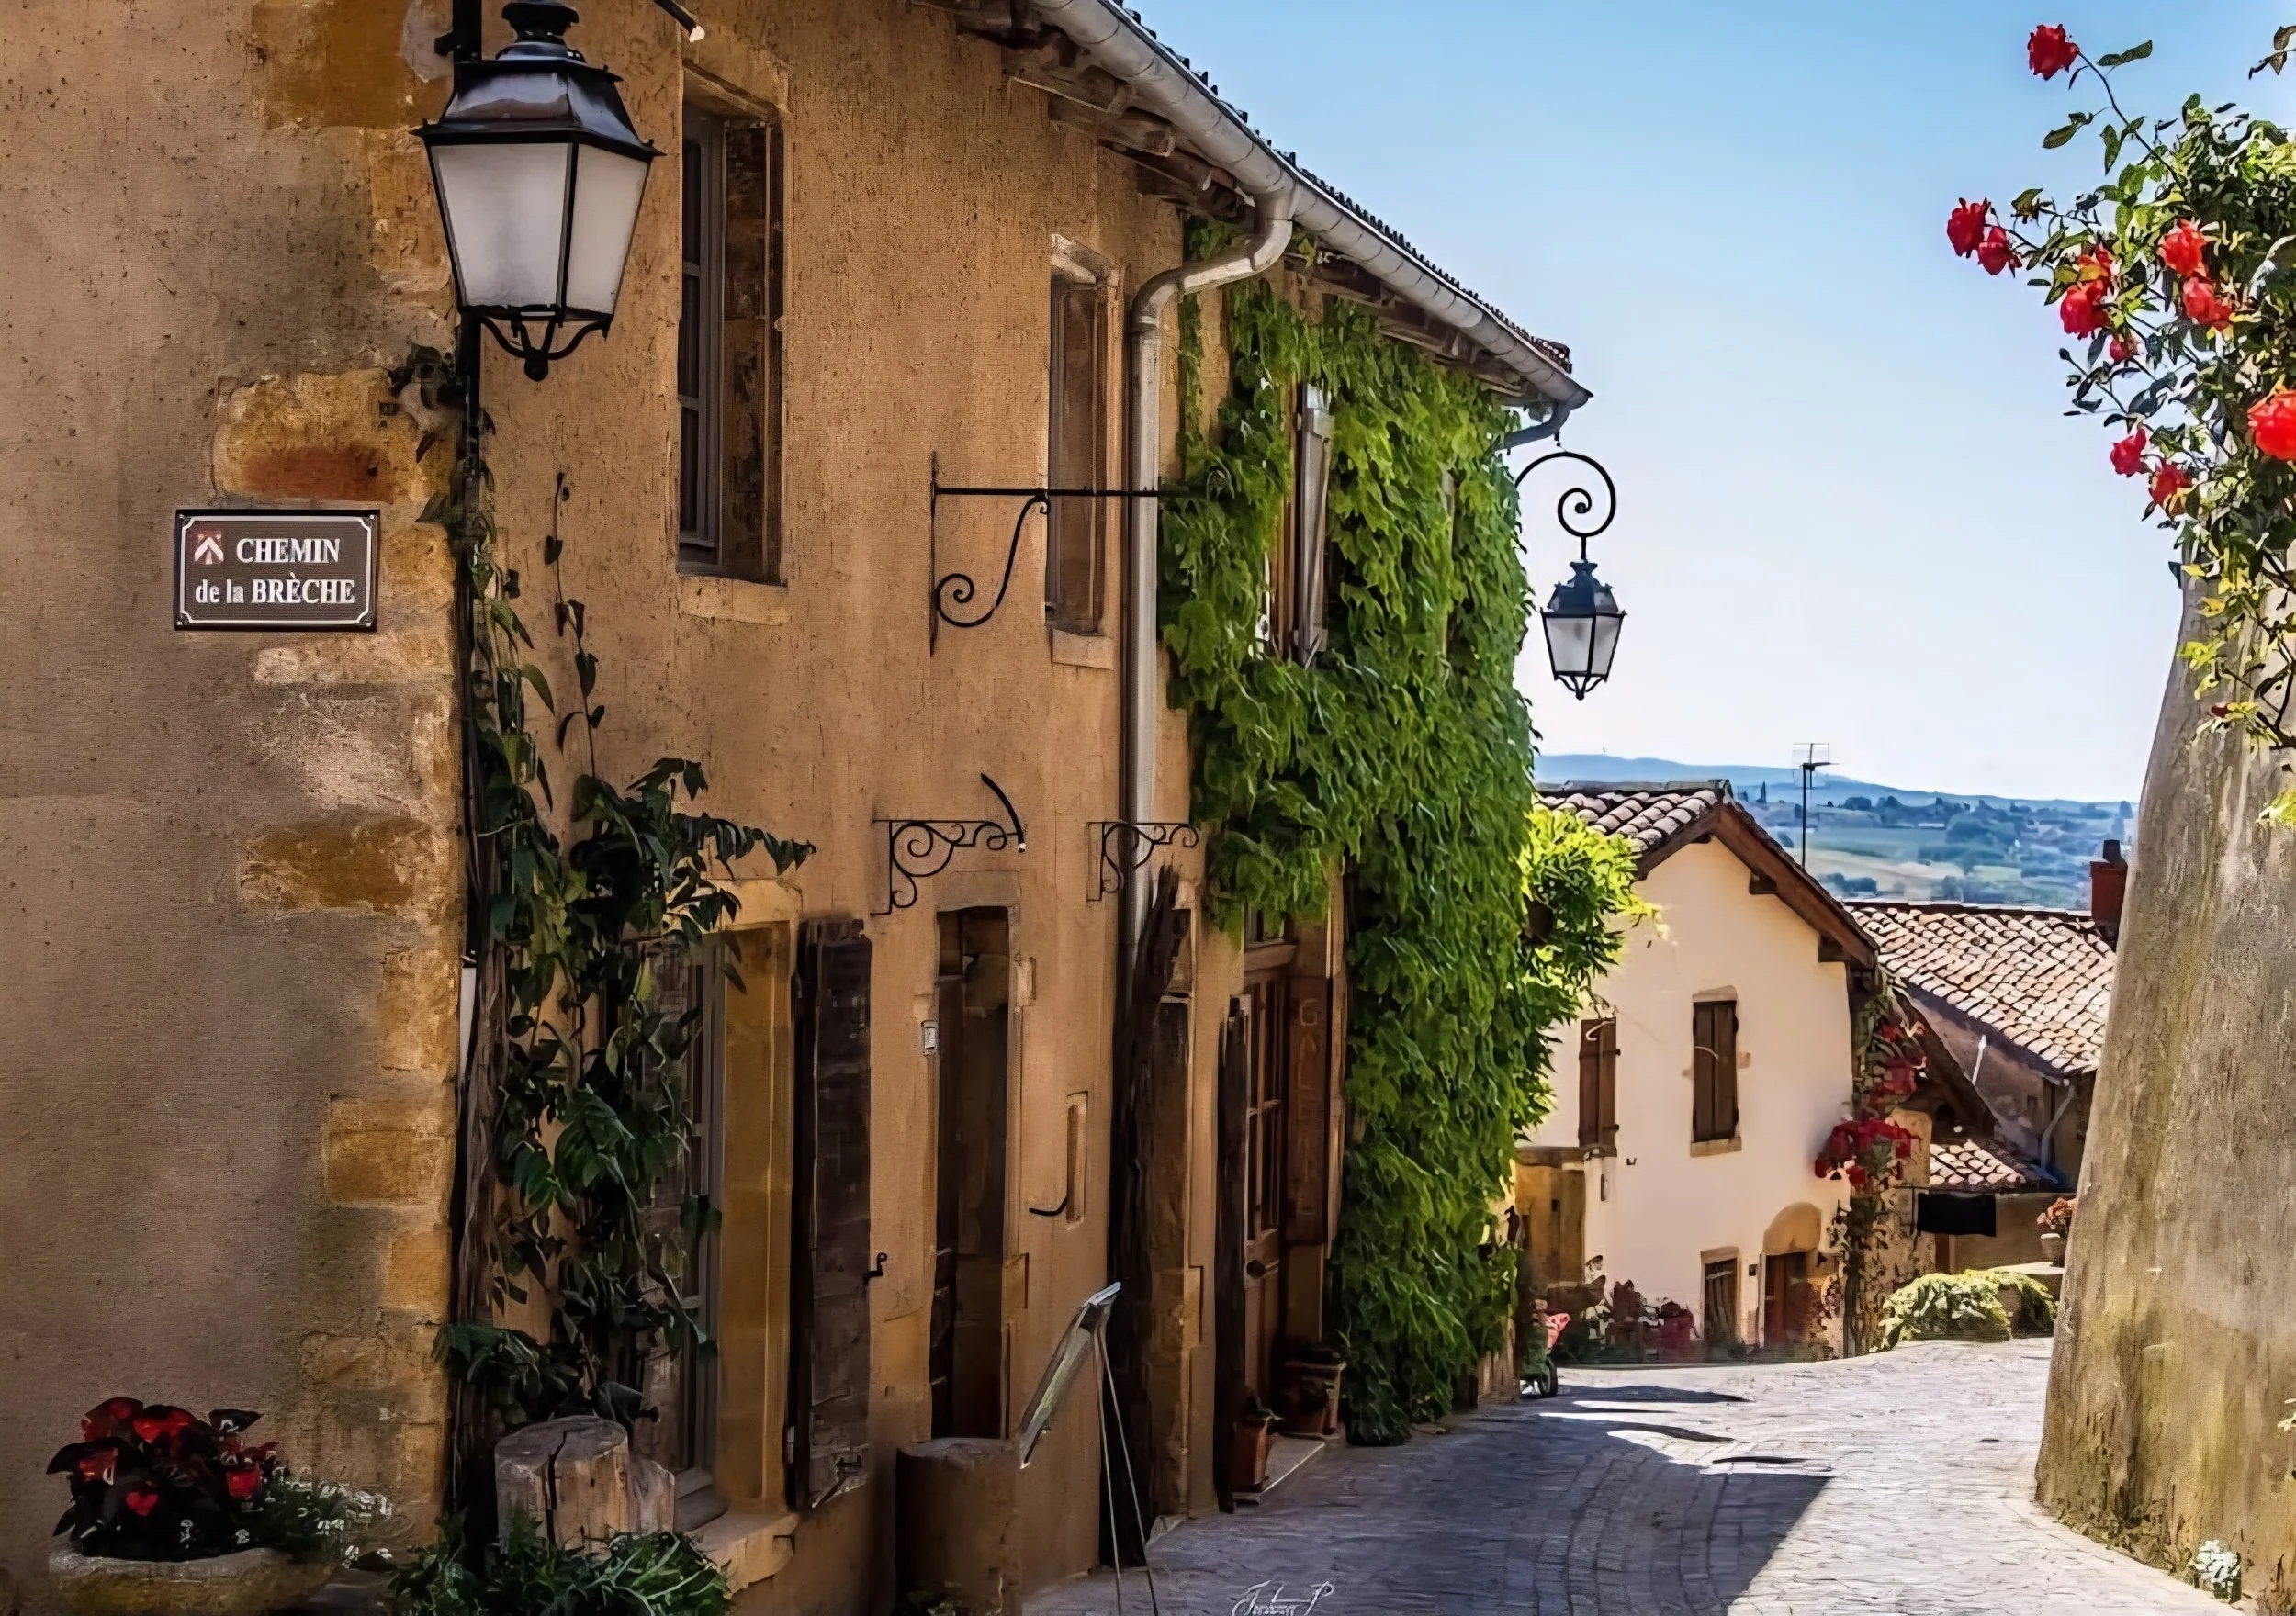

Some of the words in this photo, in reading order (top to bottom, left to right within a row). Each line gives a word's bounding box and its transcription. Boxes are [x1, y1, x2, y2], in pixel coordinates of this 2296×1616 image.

[236, 538, 341, 563] CHEMIN
[195, 579, 220, 604] de
[226, 579, 244, 604] la
[251, 572, 355, 604] BRÈCHE
